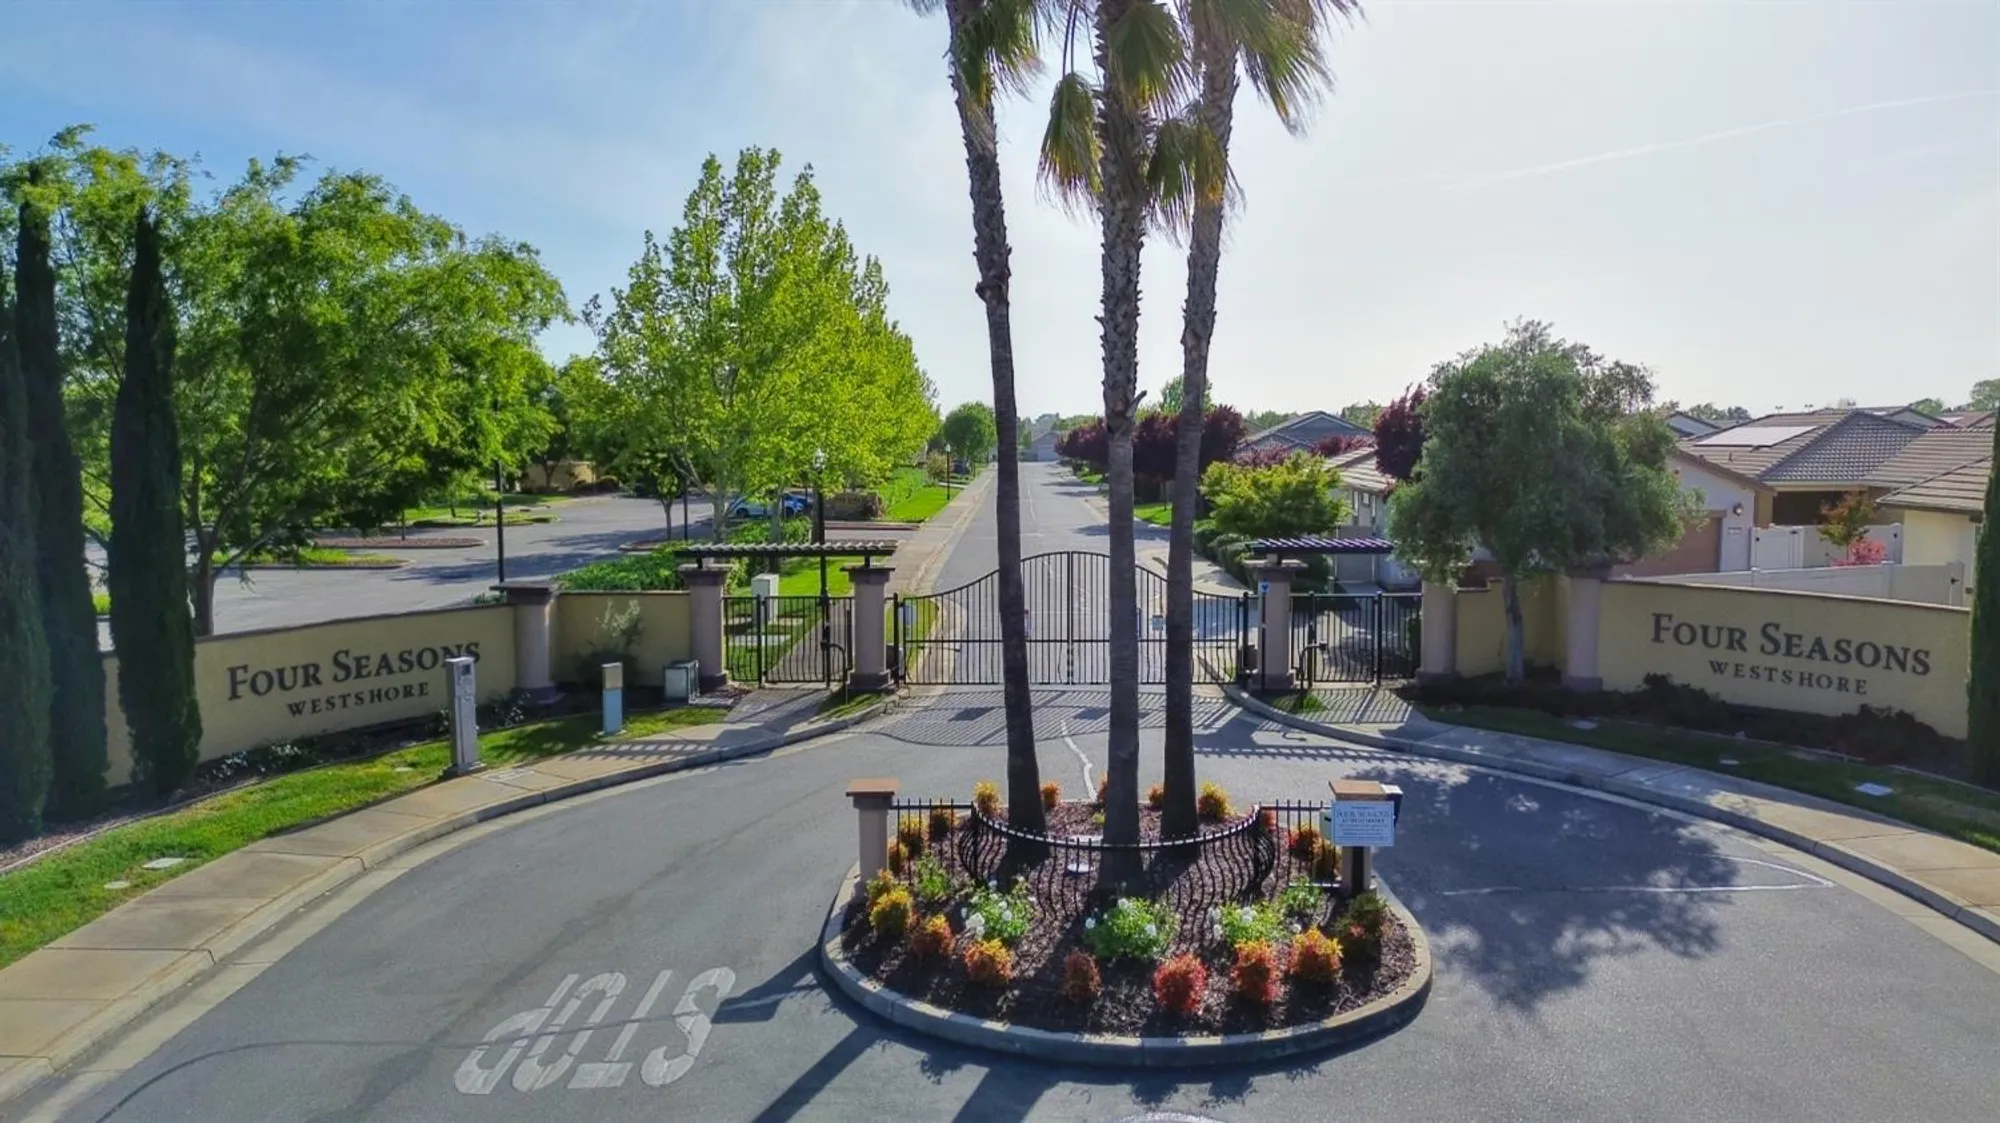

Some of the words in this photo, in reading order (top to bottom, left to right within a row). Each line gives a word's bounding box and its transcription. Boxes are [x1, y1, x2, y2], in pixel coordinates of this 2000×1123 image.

[1651, 612, 1748, 653] FOUR
[1759, 622, 1932, 676] SEASONS
[226, 662, 323, 700] FOUR
[1707, 659, 1868, 695] WESTSHORE
[286, 682, 430, 717] WESTSHORE
[454, 966, 736, 1095] STOP
